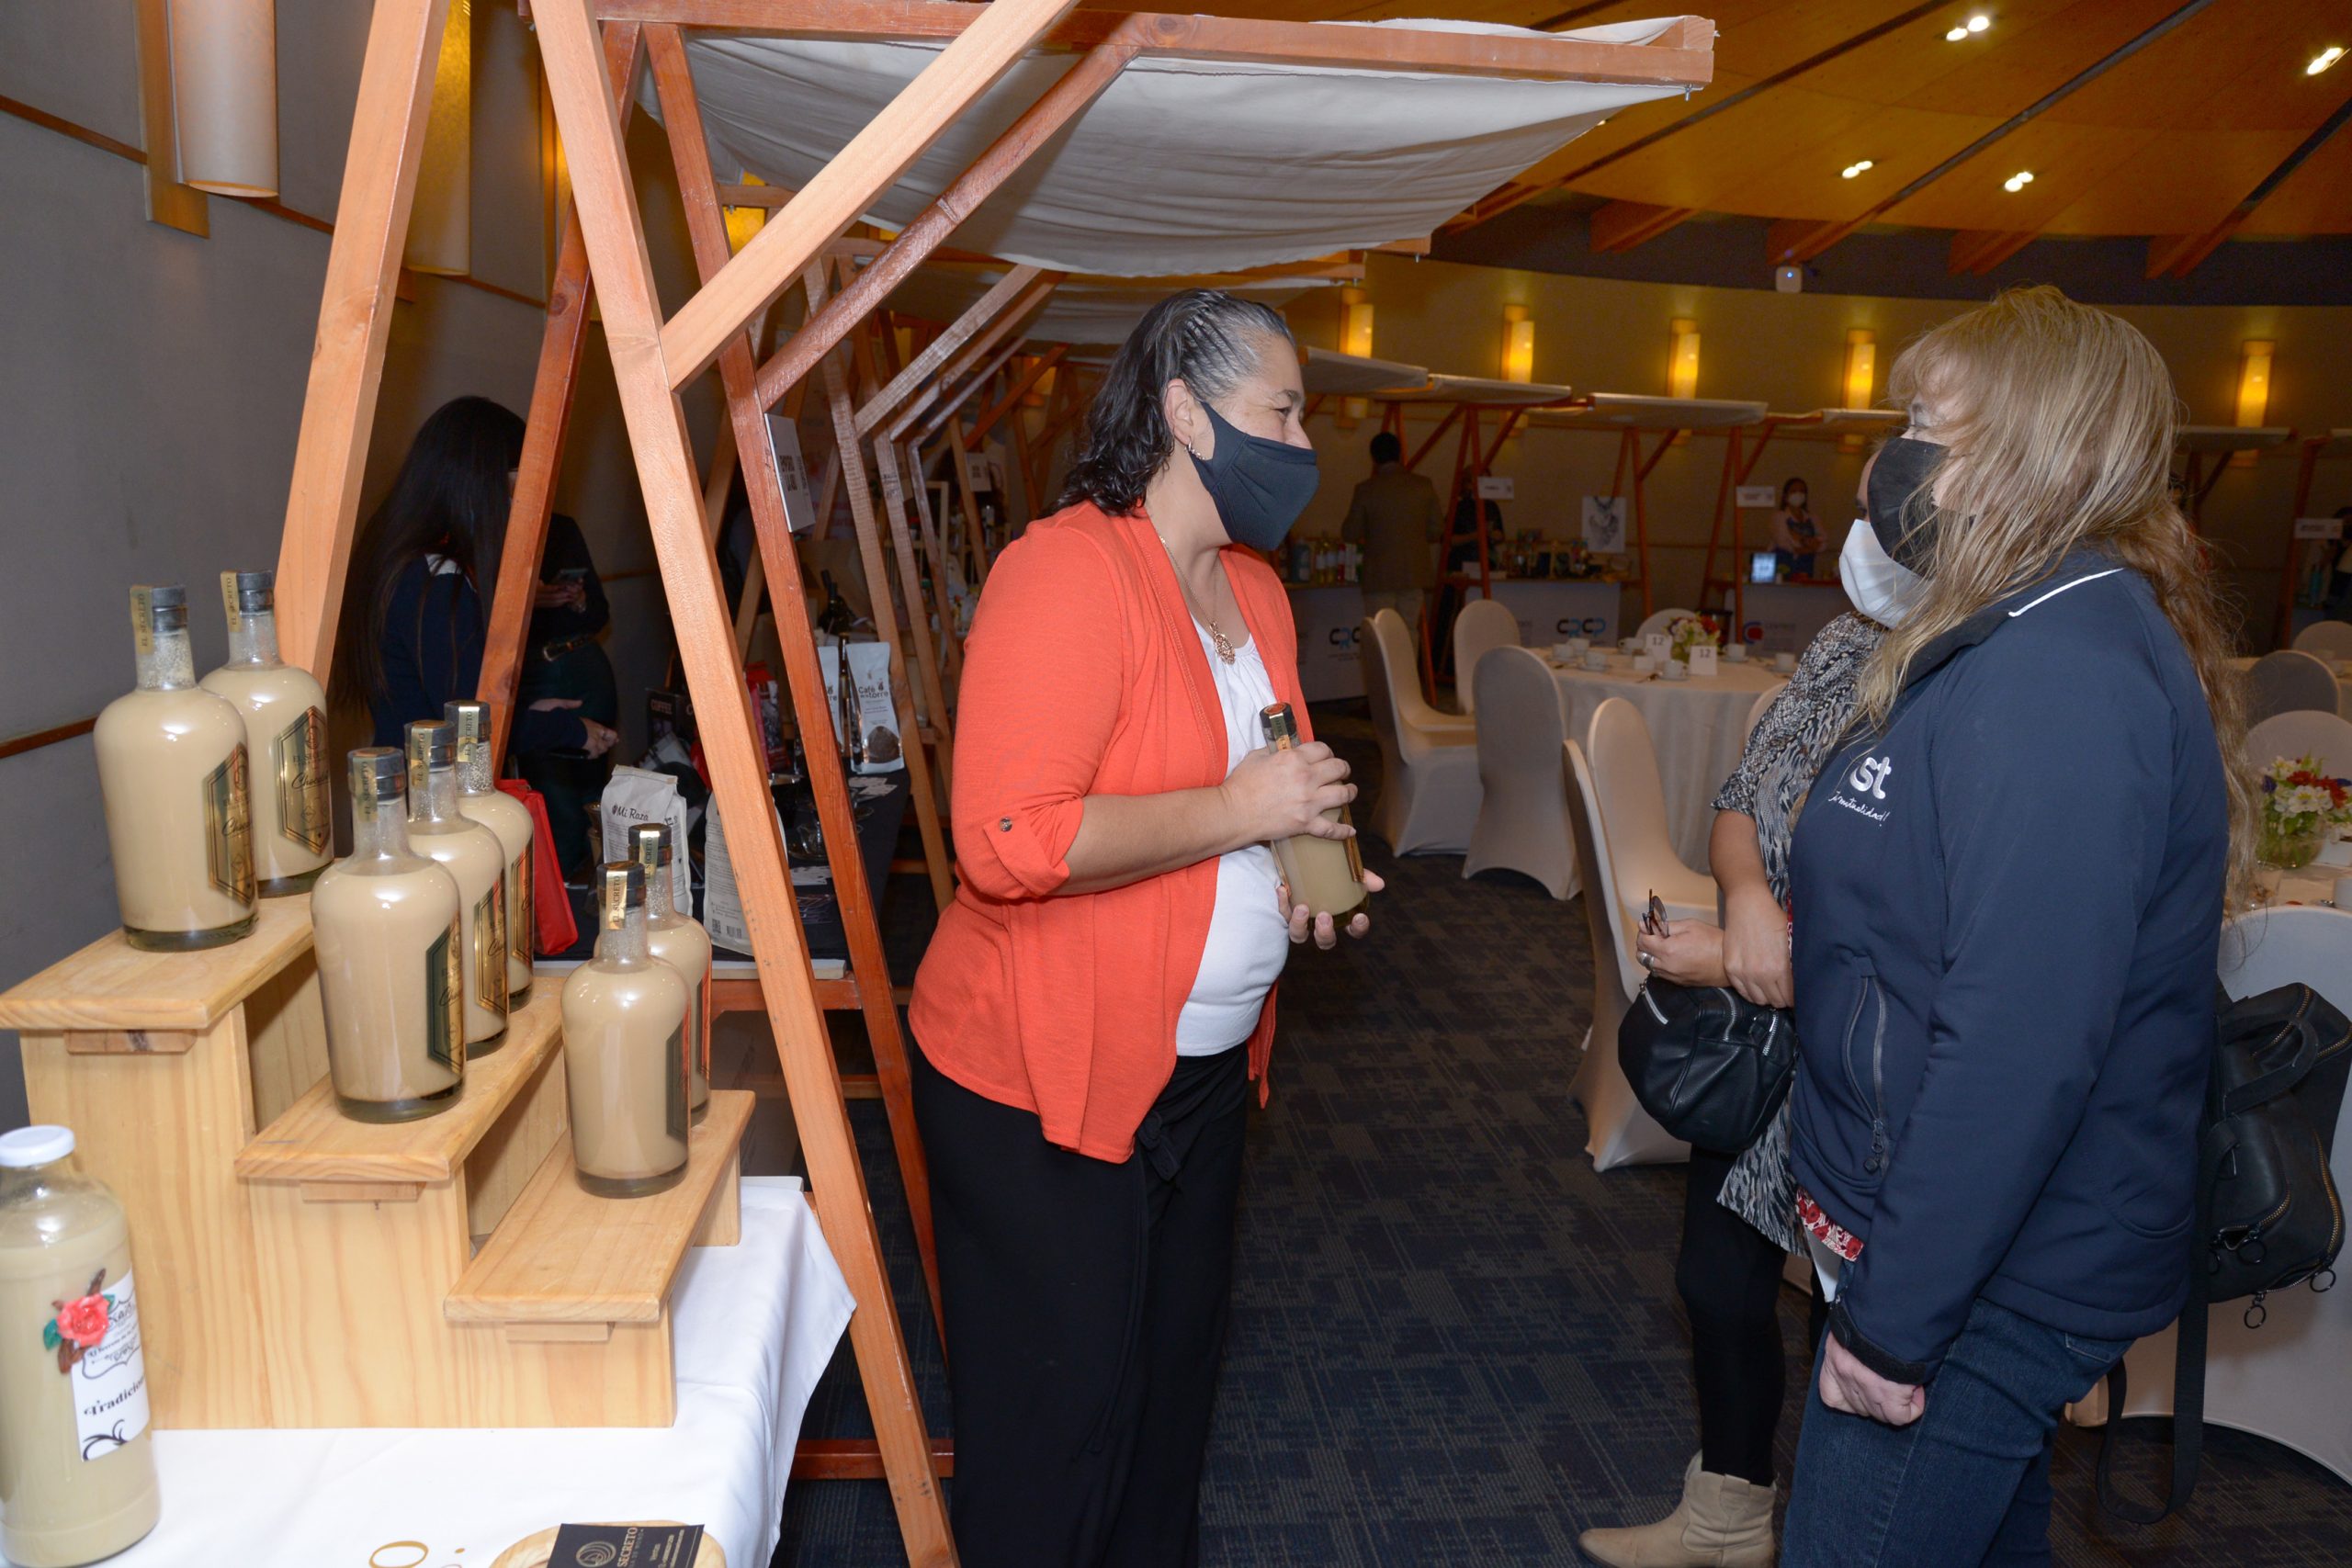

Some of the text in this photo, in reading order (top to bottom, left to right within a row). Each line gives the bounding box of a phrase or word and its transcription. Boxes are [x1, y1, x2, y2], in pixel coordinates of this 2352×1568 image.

[138, 592, 148, 647] EL SECRETO
[232, 615, 237, 626] EL
[1329, 626, 1362, 649] CRC
[1652, 637, 1665, 647] 12
[1699, 648, 1712, 659] 12
[417, 732, 425, 770] SECRETO
[465, 748, 471, 756] EL
[360, 761, 370, 801] SECRETO
[616, 805, 628, 818] Mi
[629, 807, 650, 822] Raza
[645, 836, 653, 869] SECRETO
[613, 874, 621, 923] EL SECRETO
[616, 1527, 639, 1568] SECRETO
